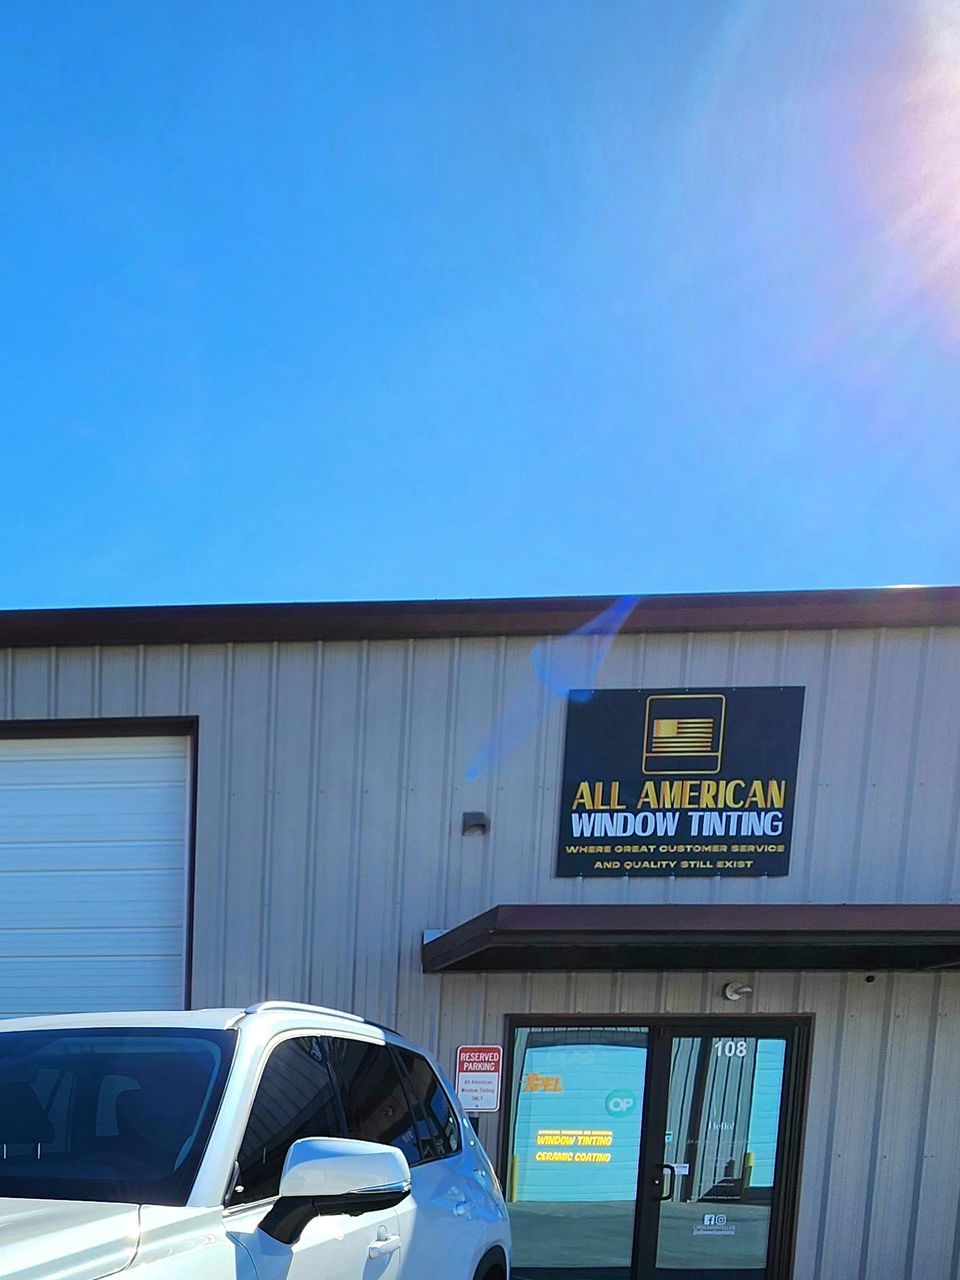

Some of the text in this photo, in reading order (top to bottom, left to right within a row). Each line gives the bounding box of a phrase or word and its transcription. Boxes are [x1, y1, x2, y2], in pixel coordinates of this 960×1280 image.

[572, 779, 786, 810] ALL AMERICAN
[571, 811, 783, 838] WINDOW TINTING
[565, 844, 785, 853] WHERE GREAT CUSTOMER SERVICE
[593, 860, 753, 870] AND QUALITY STILL EXIST
[714, 1041, 747, 1057] 108
[460, 1052, 499, 1062] RESERVED
[463, 1062, 495, 1071] PARKING
[537, 1135, 613, 1147] WINDOW TINTING
[536, 1151, 612, 1163] CERAMIC COATING
